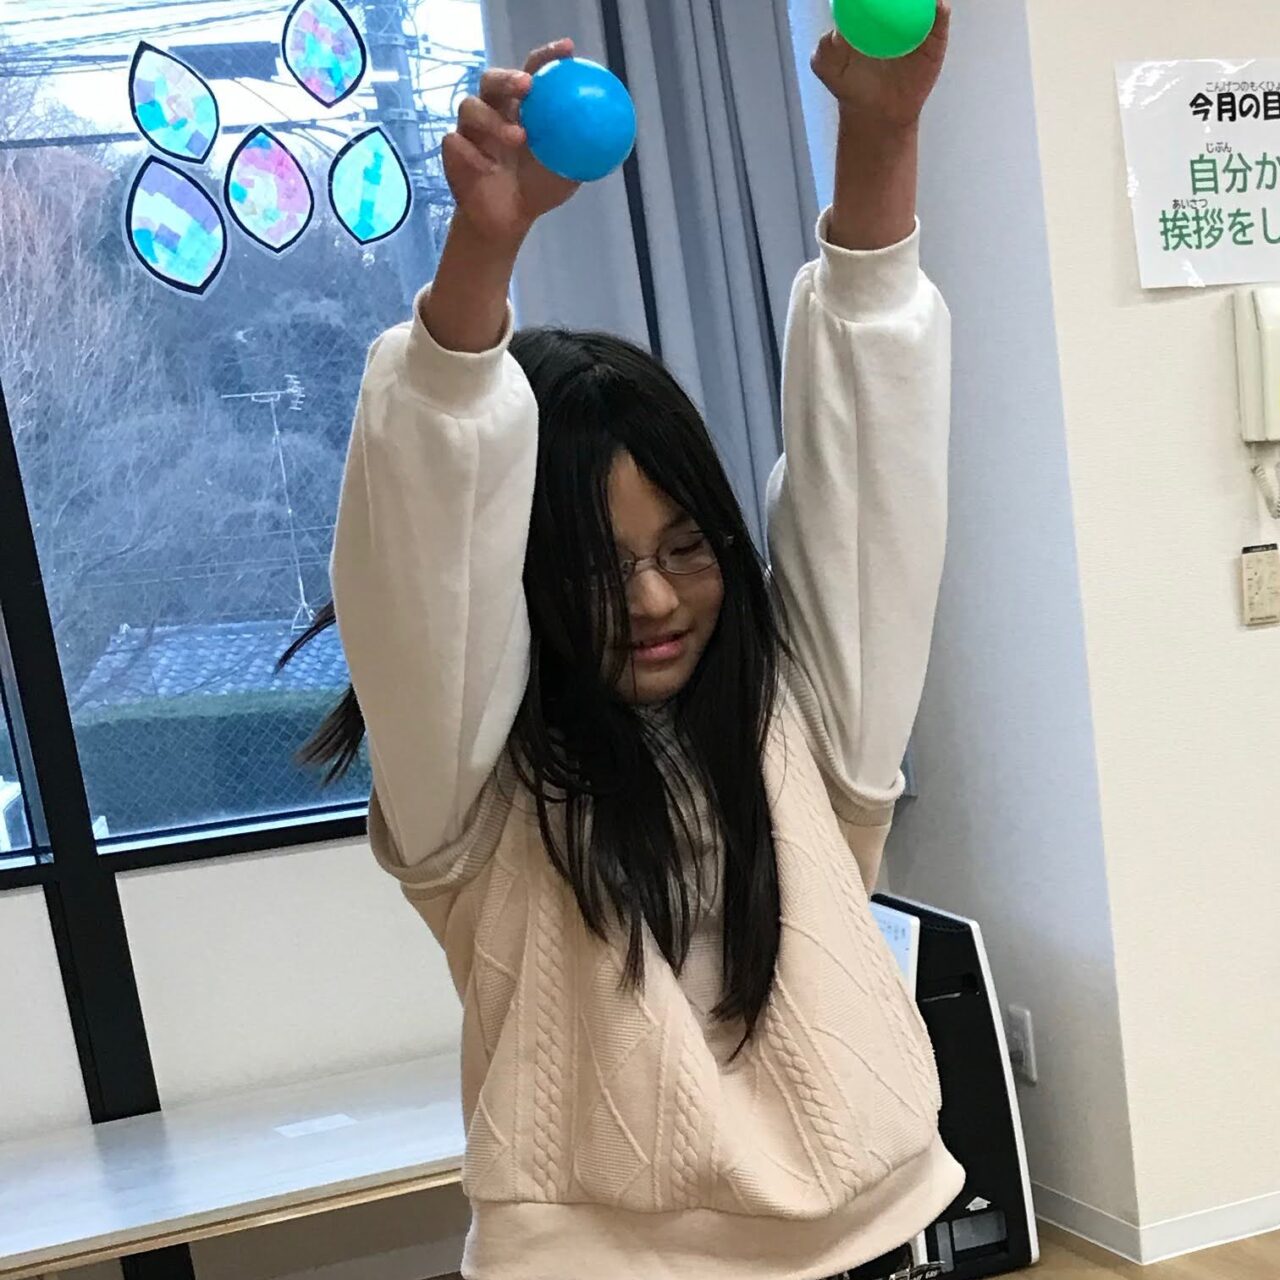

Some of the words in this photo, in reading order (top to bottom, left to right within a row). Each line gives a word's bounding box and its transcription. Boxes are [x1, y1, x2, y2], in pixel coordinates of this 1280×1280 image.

[1205, 141, 1232, 153] じぶん
[1172, 198, 1208, 210] あいさつ
